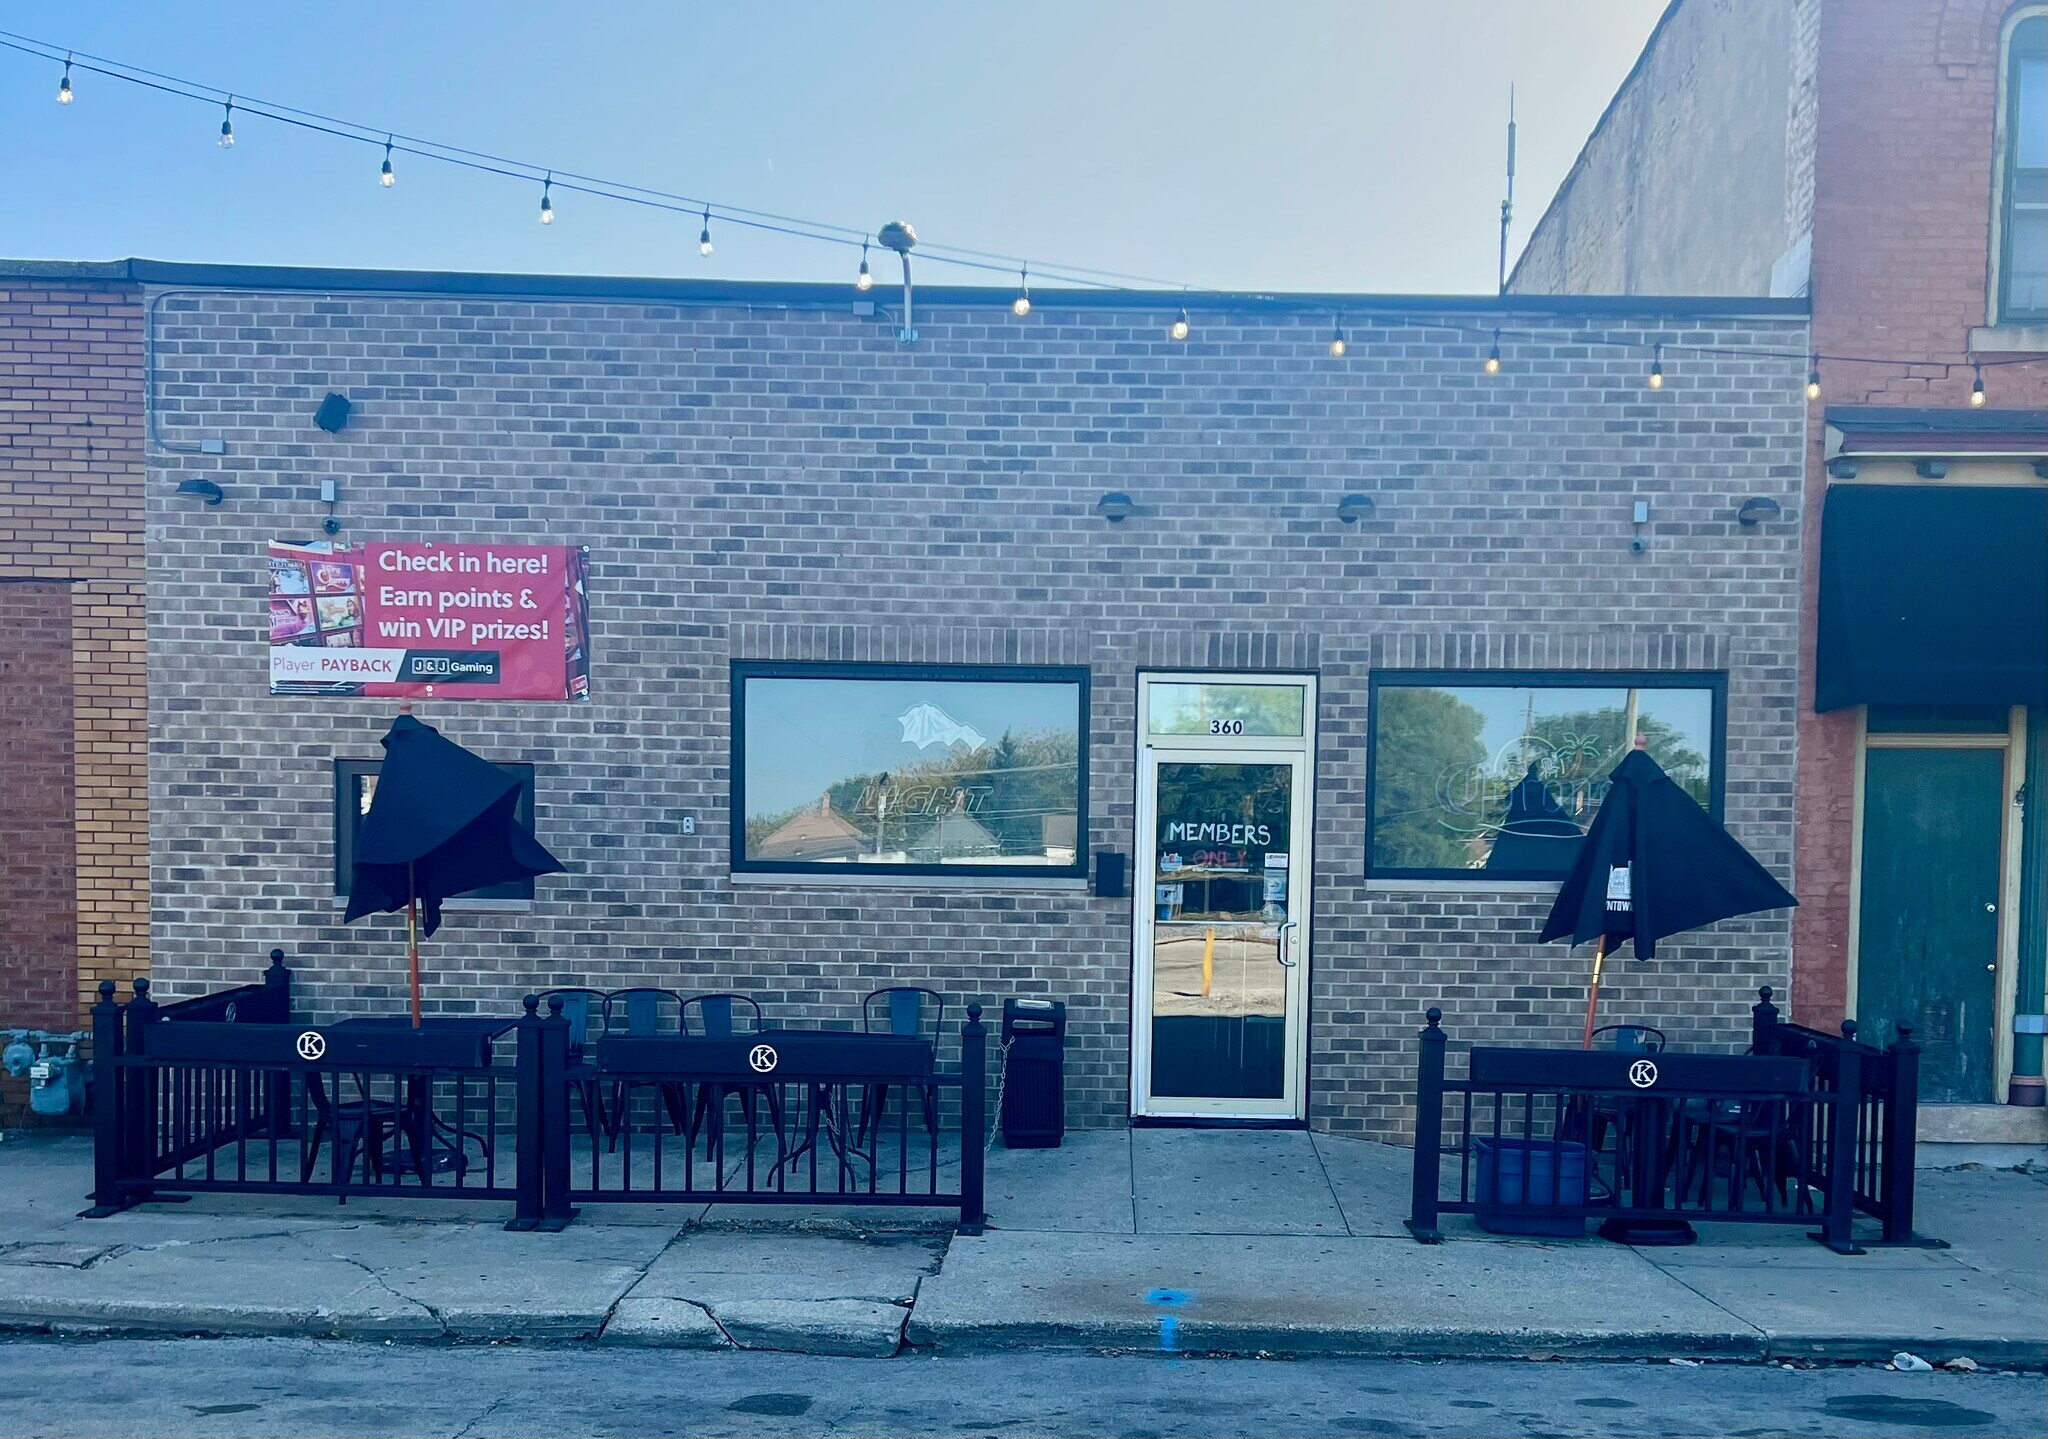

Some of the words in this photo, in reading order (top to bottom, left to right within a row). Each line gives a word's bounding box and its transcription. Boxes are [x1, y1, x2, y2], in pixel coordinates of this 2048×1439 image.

[378, 550, 452, 573] Check
[459, 551, 481, 572] in
[486, 554, 548, 575] here!
[380, 586, 432, 608] Earn
[438, 587, 514, 613] points
[518, 588, 538, 609] &
[378, 617, 422, 638] win
[425, 619, 467, 639] VIP
[471, 619, 549, 645] prizes!
[273, 657, 315, 673] Player
[321, 658, 392, 673] PAYBACK
[450, 661, 494, 674] Gaming
[1210, 720, 1243, 735] 360
[853, 785, 994, 817] LIGHT
[1435, 761, 1613, 823] Coron
[1169, 822, 1271, 846] MEMBERS
[1193, 850, 1247, 867] ONLY
